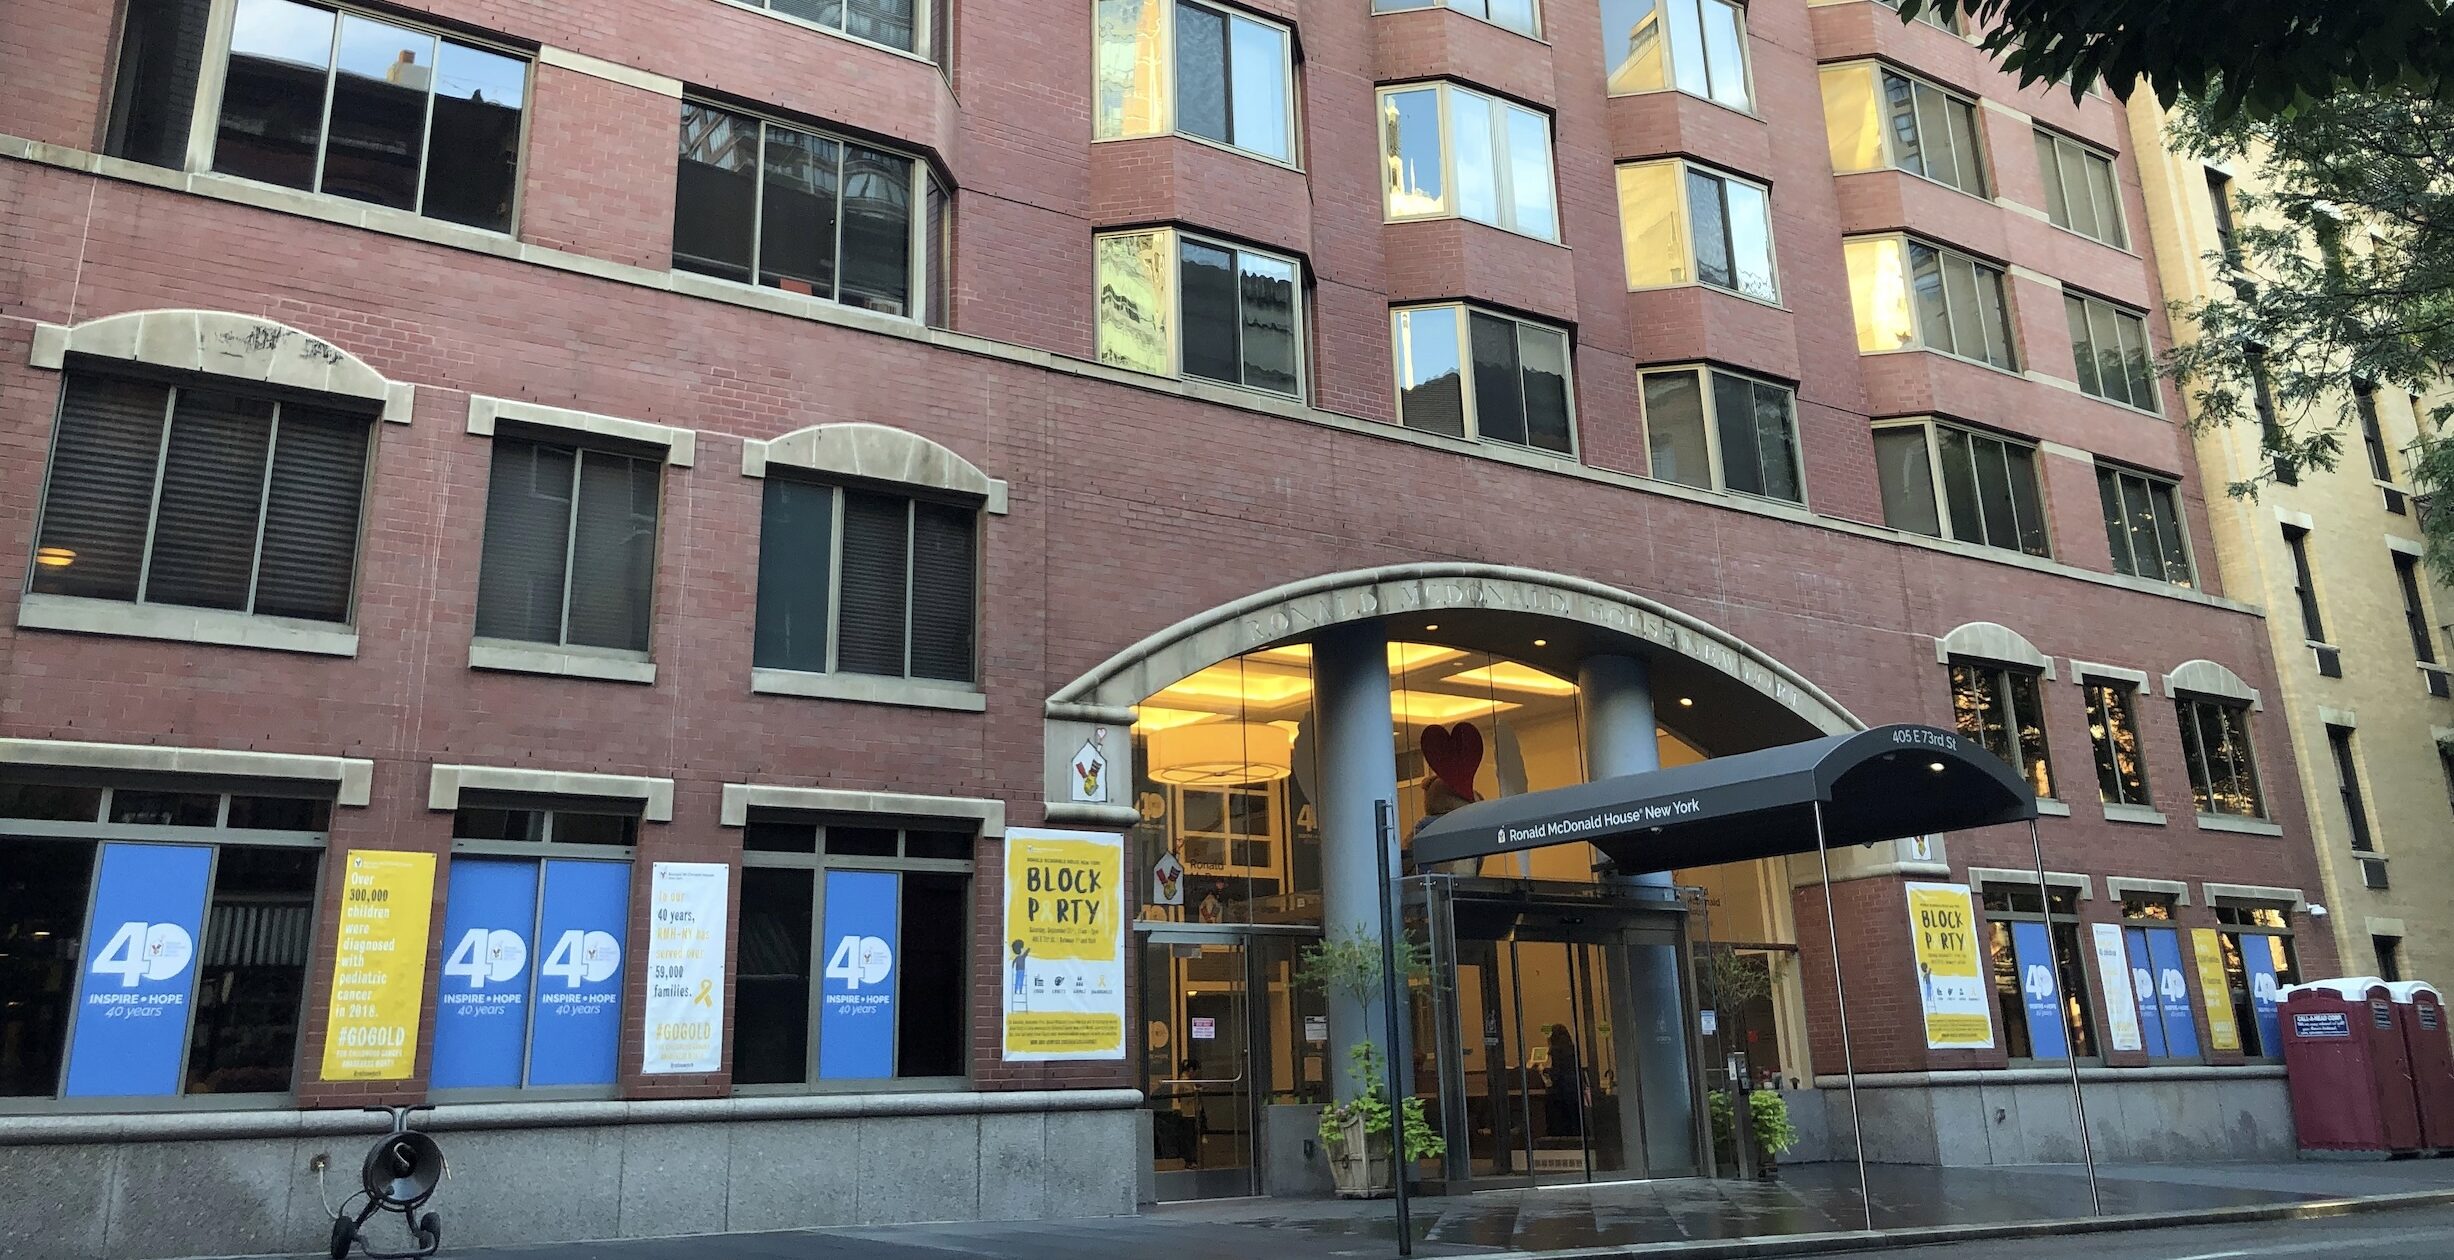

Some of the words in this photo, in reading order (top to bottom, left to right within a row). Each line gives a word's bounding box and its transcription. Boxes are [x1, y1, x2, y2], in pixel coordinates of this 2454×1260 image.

[1246, 585, 1378, 642] RONALD
[1590, 601, 1676, 645] HOUSE
[1684, 632, 1735, 672] NEW
[1892, 729, 1912, 743] 405
[1913, 729, 1921, 743] E
[1921, 730, 1945, 747] 73rd
[1946, 735, 1957, 751] St
[1509, 826, 1546, 842] Ronald
[1547, 814, 1602, 838] McDonald
[1644, 804, 1672, 820] New
[1672, 797, 1700, 815] York
[351, 871, 375, 885] Over
[1027, 866, 1102, 894] BLOCK
[349, 888, 389, 903] 300,000
[347, 905, 390, 918] children
[658, 908, 668, 921] 40
[670, 911, 695, 924] years,
[1921, 910, 1964, 929] BLOCK
[345, 923, 369, 935] were
[343, 937, 395, 954] diagnosed
[92, 922, 193, 987] 40
[341, 953, 365, 967] with
[444, 928, 527, 988] 40
[542, 929, 621, 988] 40
[826, 935, 892, 989] 40
[339, 970, 387, 987] pediatric
[655, 965, 684, 980] 59,000
[2025, 964, 2054, 1000] 40
[2161, 968, 2186, 1002] 40
[337, 990, 373, 1001] cancer
[654, 984, 692, 997] families.
[89, 994, 140, 1004] INSPIRE
[149, 994, 184, 1004] HOPE
[443, 994, 485, 1004] INSPIRE
[493, 994, 522, 1004] HOPE
[542, 994, 581, 1004] INSPIRE
[589, 994, 616, 1004] HOPE
[826, 995, 860, 1004] INSPIRE
[866, 995, 890, 1004] HOPE
[105, 1006, 123, 1018] 40
[124, 1006, 163, 1020] years
[336, 1004, 345, 1018] in
[457, 1005, 473, 1016] 40
[474, 1005, 505, 1017] years
[555, 1005, 571, 1016] 40
[571, 1005, 601, 1017] years
[839, 1005, 851, 1015] 40
[852, 1005, 877, 1016] years
[338, 1026, 405, 1046] #GOGOLD
[656, 1022, 711, 1040] #GOGOLD
